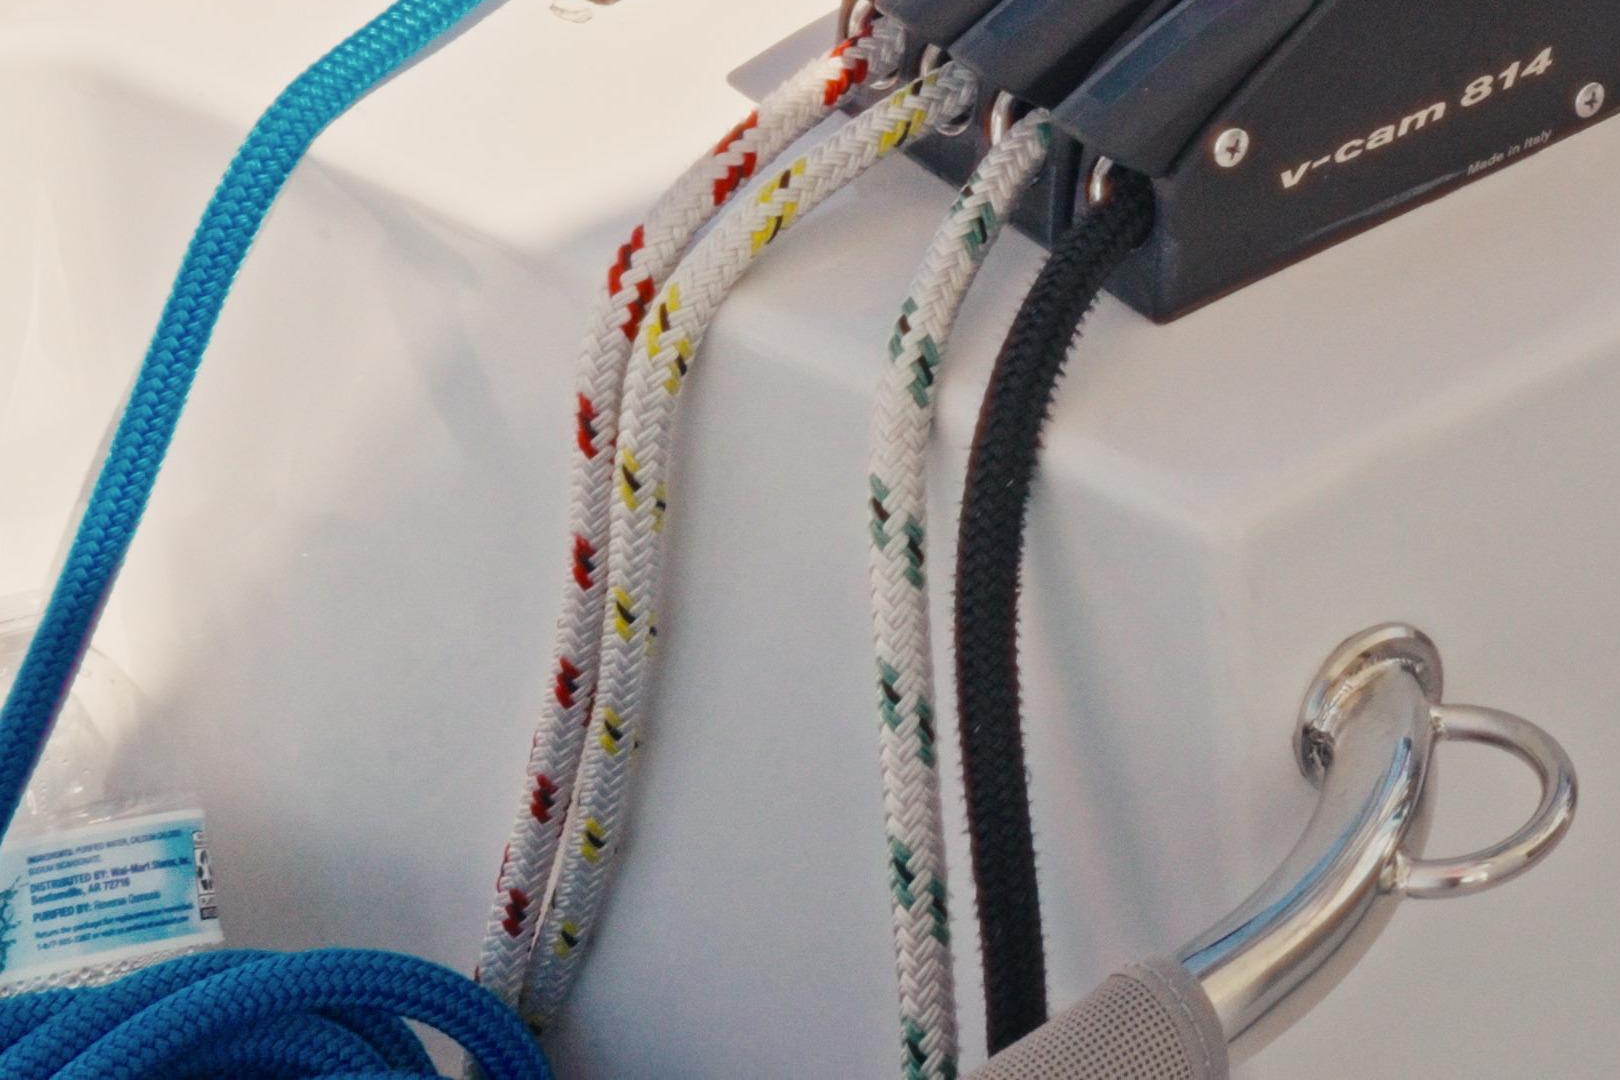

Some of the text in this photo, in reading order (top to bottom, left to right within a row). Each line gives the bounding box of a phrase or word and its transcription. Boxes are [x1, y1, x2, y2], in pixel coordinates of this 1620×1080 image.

[1460, 46, 1553, 107] 814
[1466, 128, 1553, 176] Made in Italy
